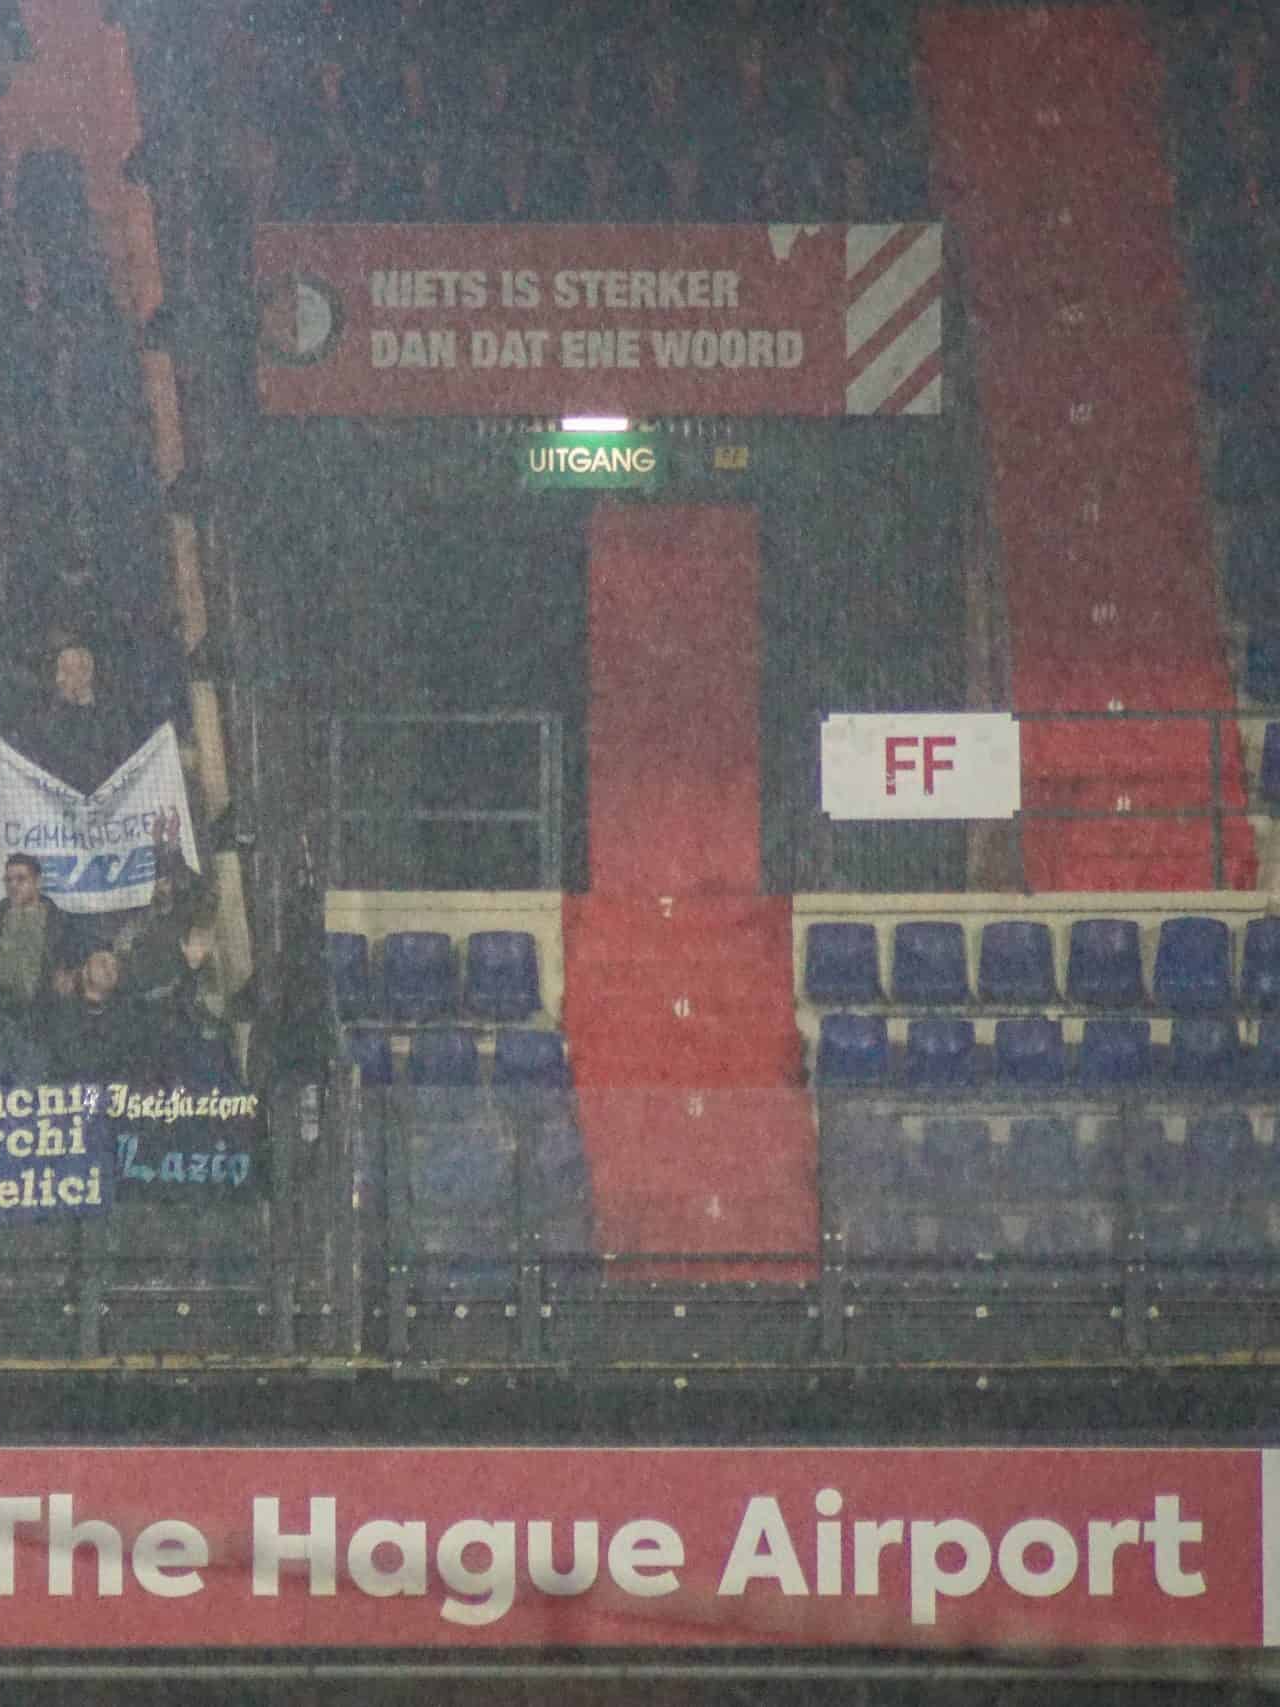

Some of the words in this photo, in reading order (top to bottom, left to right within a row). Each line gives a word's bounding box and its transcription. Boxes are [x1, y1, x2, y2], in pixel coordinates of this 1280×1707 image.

[370, 270, 489, 309] NIETS
[501, 269, 540, 308] IS
[554, 269, 740, 308] STERKER
[370, 331, 454, 370] DAN
[471, 331, 548, 369] DAT
[560, 330, 639, 369] ENE
[650, 330, 805, 370] WOORD
[529, 447, 656, 473] UITGANG
[886, 736, 956, 795] FF
[117, 1134, 250, 1187] Lazio
[251, 1495, 686, 1626] Hague
[718, 1488, 1208, 1625] Airport
